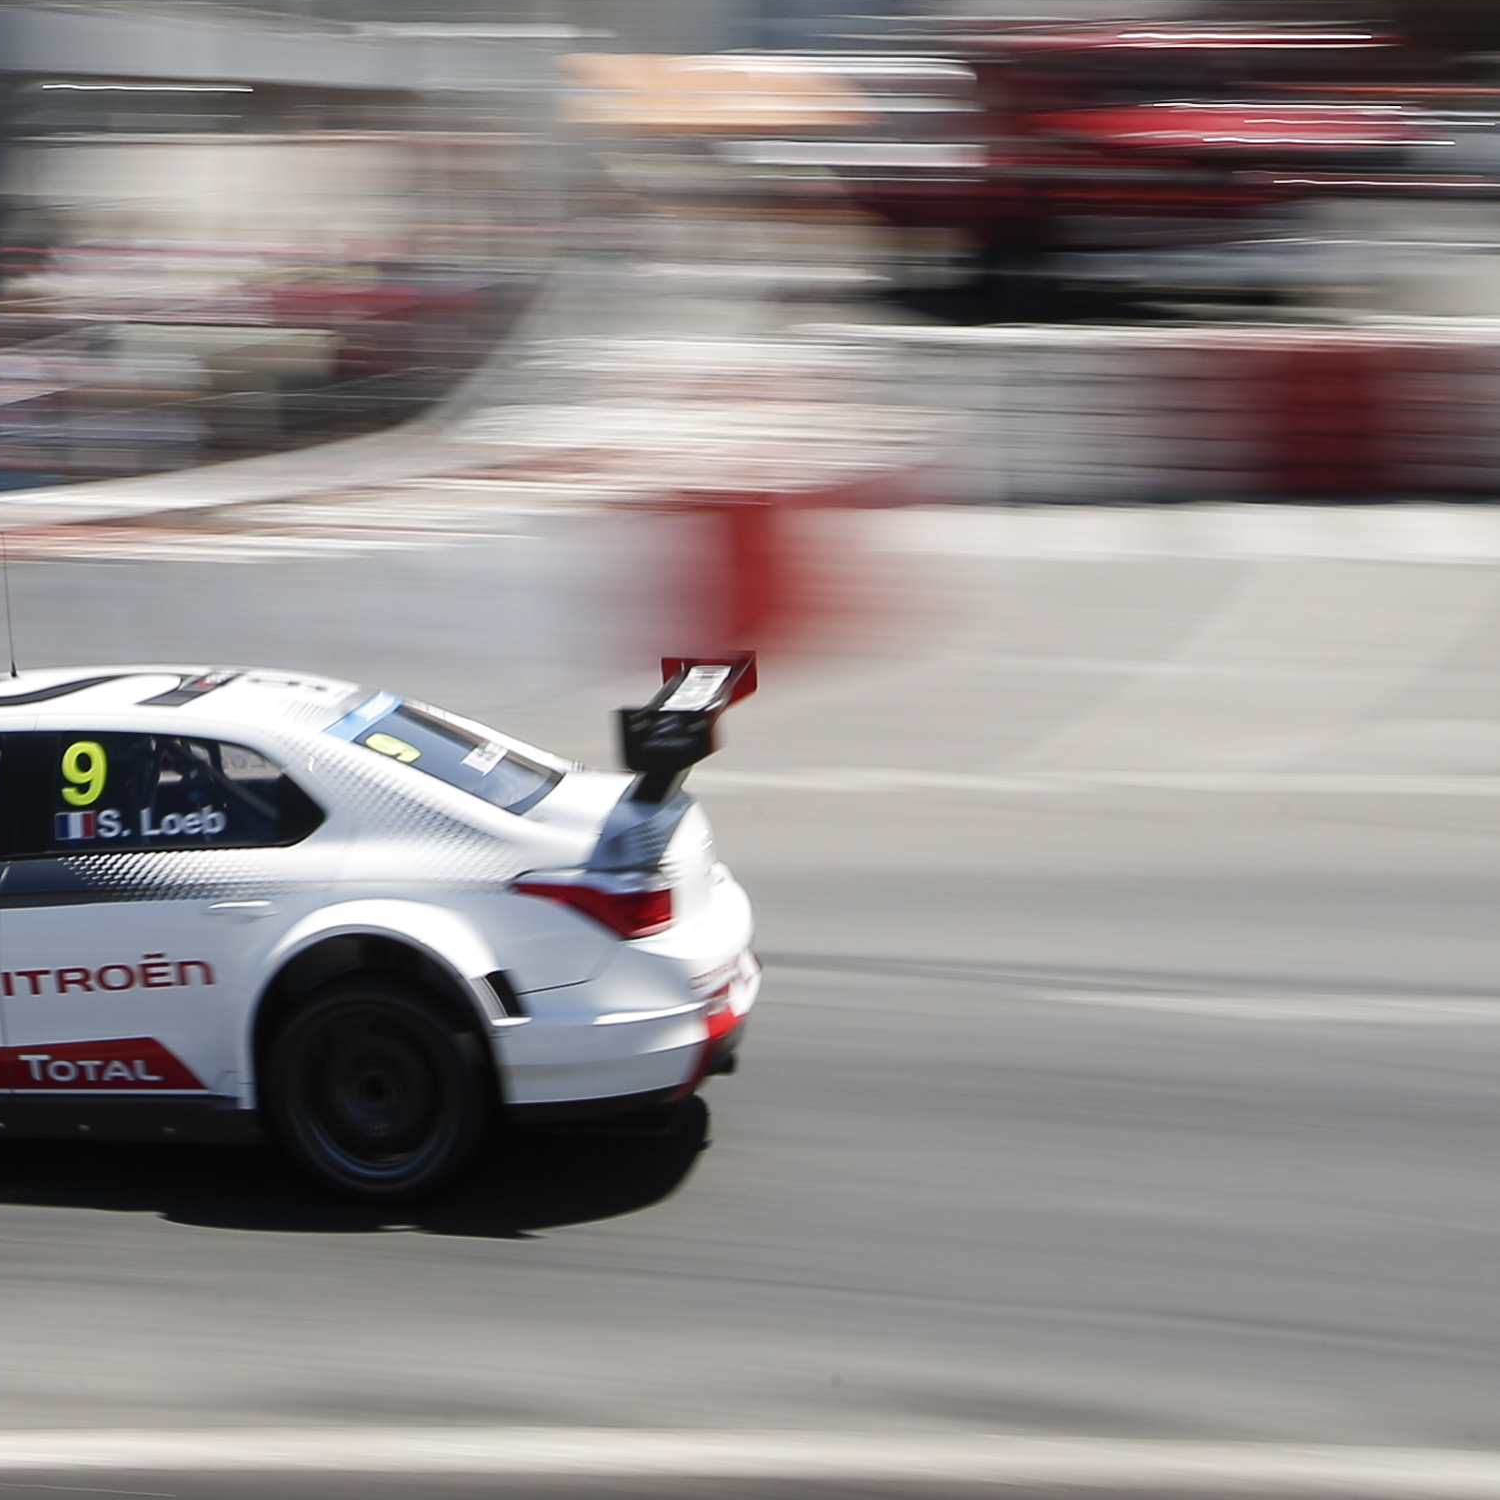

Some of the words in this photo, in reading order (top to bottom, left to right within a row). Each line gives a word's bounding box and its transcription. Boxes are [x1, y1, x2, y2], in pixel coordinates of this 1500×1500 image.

[61, 740, 107, 806] 9
[97, 809, 132, 838] S.
[140, 805, 227, 837] Loeb
